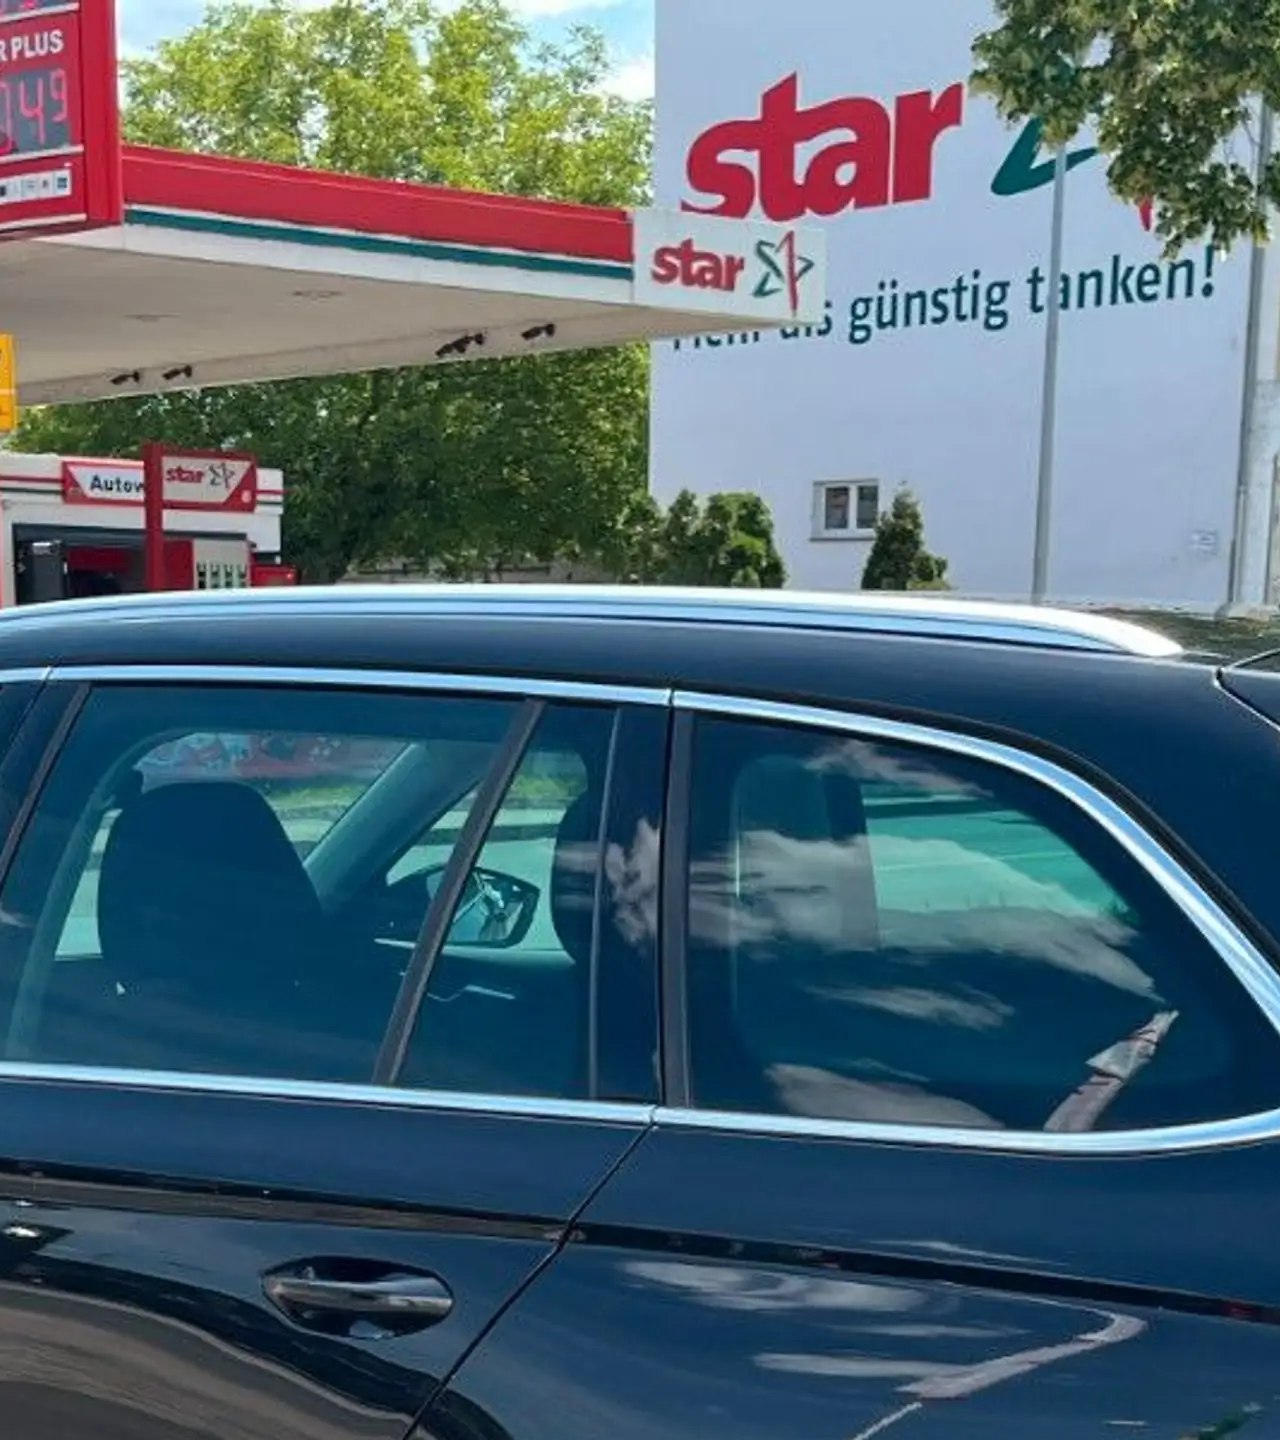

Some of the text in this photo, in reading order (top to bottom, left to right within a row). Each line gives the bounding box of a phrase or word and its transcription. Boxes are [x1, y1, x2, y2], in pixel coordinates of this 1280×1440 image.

[11, 29, 64, 62] PLUS
[680, 71, 963, 222] star
[651, 237, 745, 292] star
[849, 268, 1011, 345] günstig
[166, 465, 205, 484] star
